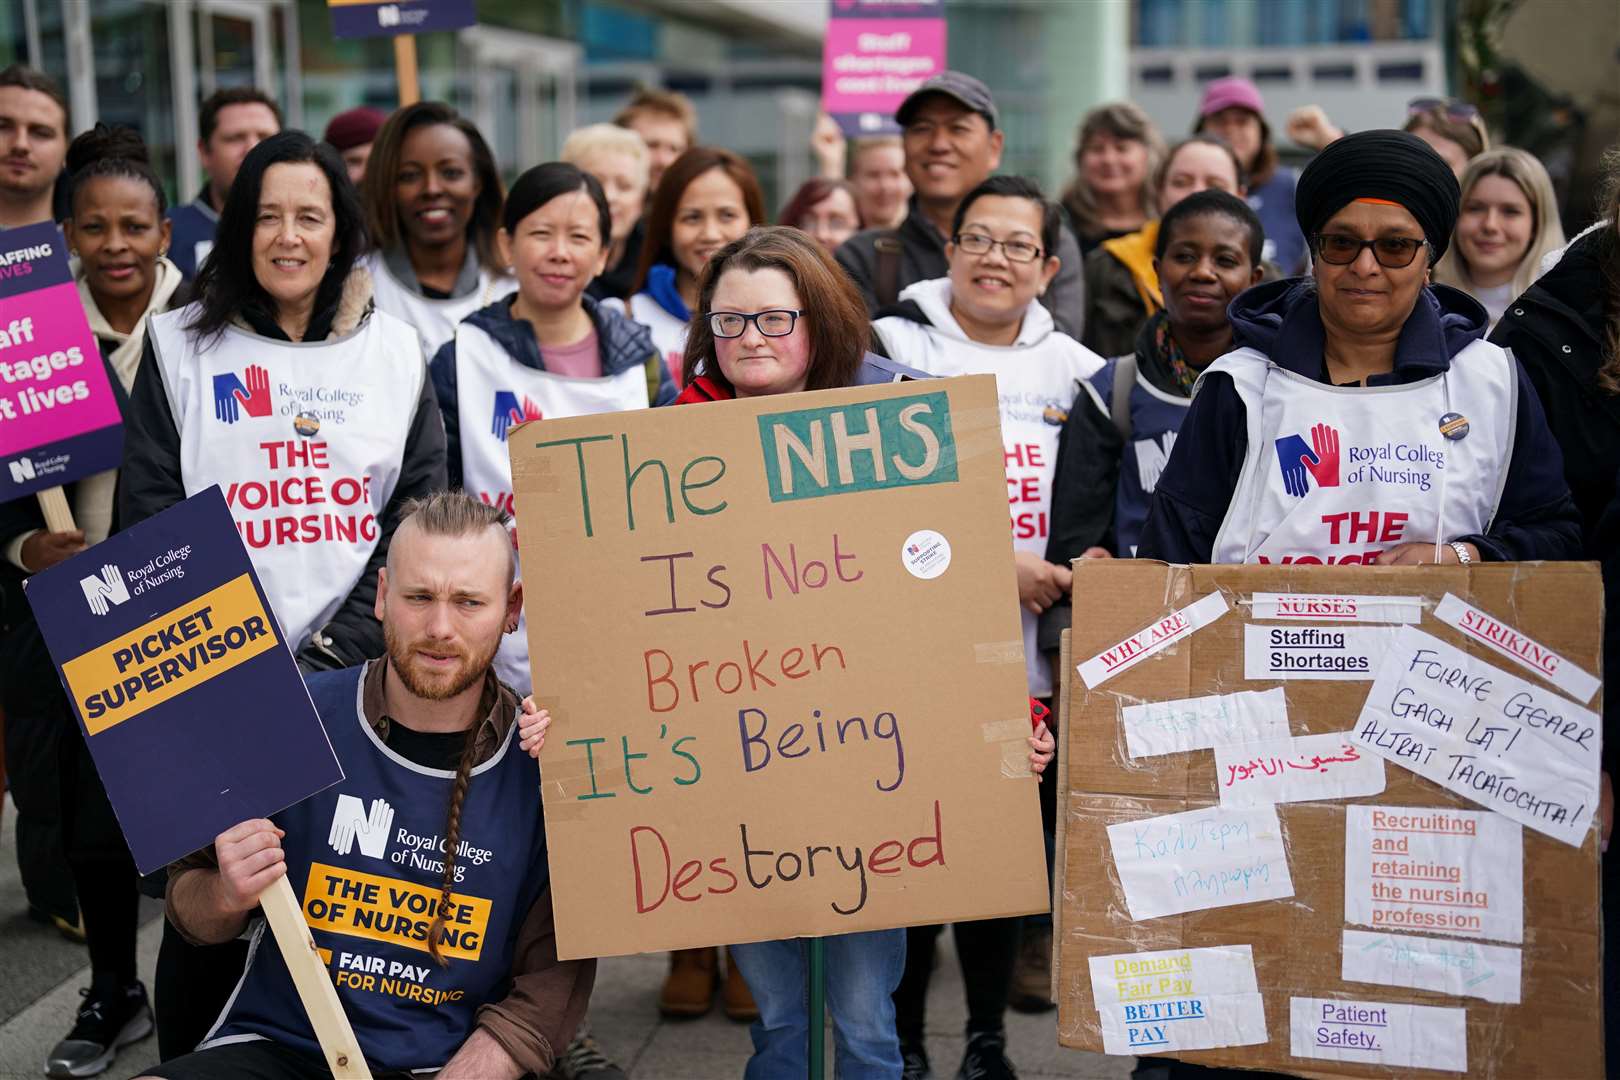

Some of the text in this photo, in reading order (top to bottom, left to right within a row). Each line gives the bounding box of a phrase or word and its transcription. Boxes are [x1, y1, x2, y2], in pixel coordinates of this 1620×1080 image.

[0, 243, 53, 267] AFFING
[0, 317, 34, 350] aff
[0, 346, 84, 383] tages
[18, 380, 90, 415] lives
[316, 387, 365, 406] College
[260, 440, 330, 470] THE
[536, 402, 941, 537] The NHS
[1003, 443, 1045, 467] HE
[1349, 443, 1444, 469] Royal Colleg
[1347, 466, 1431, 491] of Nursing
[1321, 511, 1409, 545] THE
[127, 543, 192, 582] Royal College
[640, 534, 864, 617] Is Not
[134, 564, 186, 596] of Nursing
[1277, 597, 1357, 616] NURSES
[112, 606, 213, 674] PICKET
[1099, 611, 1191, 668] WHY ARE
[1270, 629, 1345, 648] Staffing
[1461, 609, 1561, 675] STRIKING
[84, 615, 268, 719] SUPERVISOR
[644, 640, 847, 713] Broken
[1270, 652, 1369, 671] Shortages
[1391, 687, 1453, 733] GACH
[1409, 650, 1594, 751] FOIRNE GEARR
[566, 708, 905, 800] It's Being
[1372, 810, 1476, 835] Recruiting
[396, 828, 437, 852] Royal
[1372, 836, 1408, 854] and
[391, 849, 467, 882] of Nursng
[630, 799, 946, 915] Destoryed
[1371, 860, 1461, 882] retaining
[325, 875, 380, 904] THE
[1372, 882, 1488, 908] the nursing
[307, 899, 479, 951] OF NURSNG
[1372, 907, 1481, 930] profession
[339, 952, 431, 984] FAIR PAY
[1114, 953, 1193, 978] Demand
[336, 971, 465, 1007] FOR NURSING
[1117, 976, 1194, 998] Fair Pay
[1125, 1000, 1205, 1022] BETTER
[1322, 1004, 1388, 1025] Patient
[1128, 1025, 1168, 1044] PAY
[1316, 1027, 1381, 1050] Safety.
